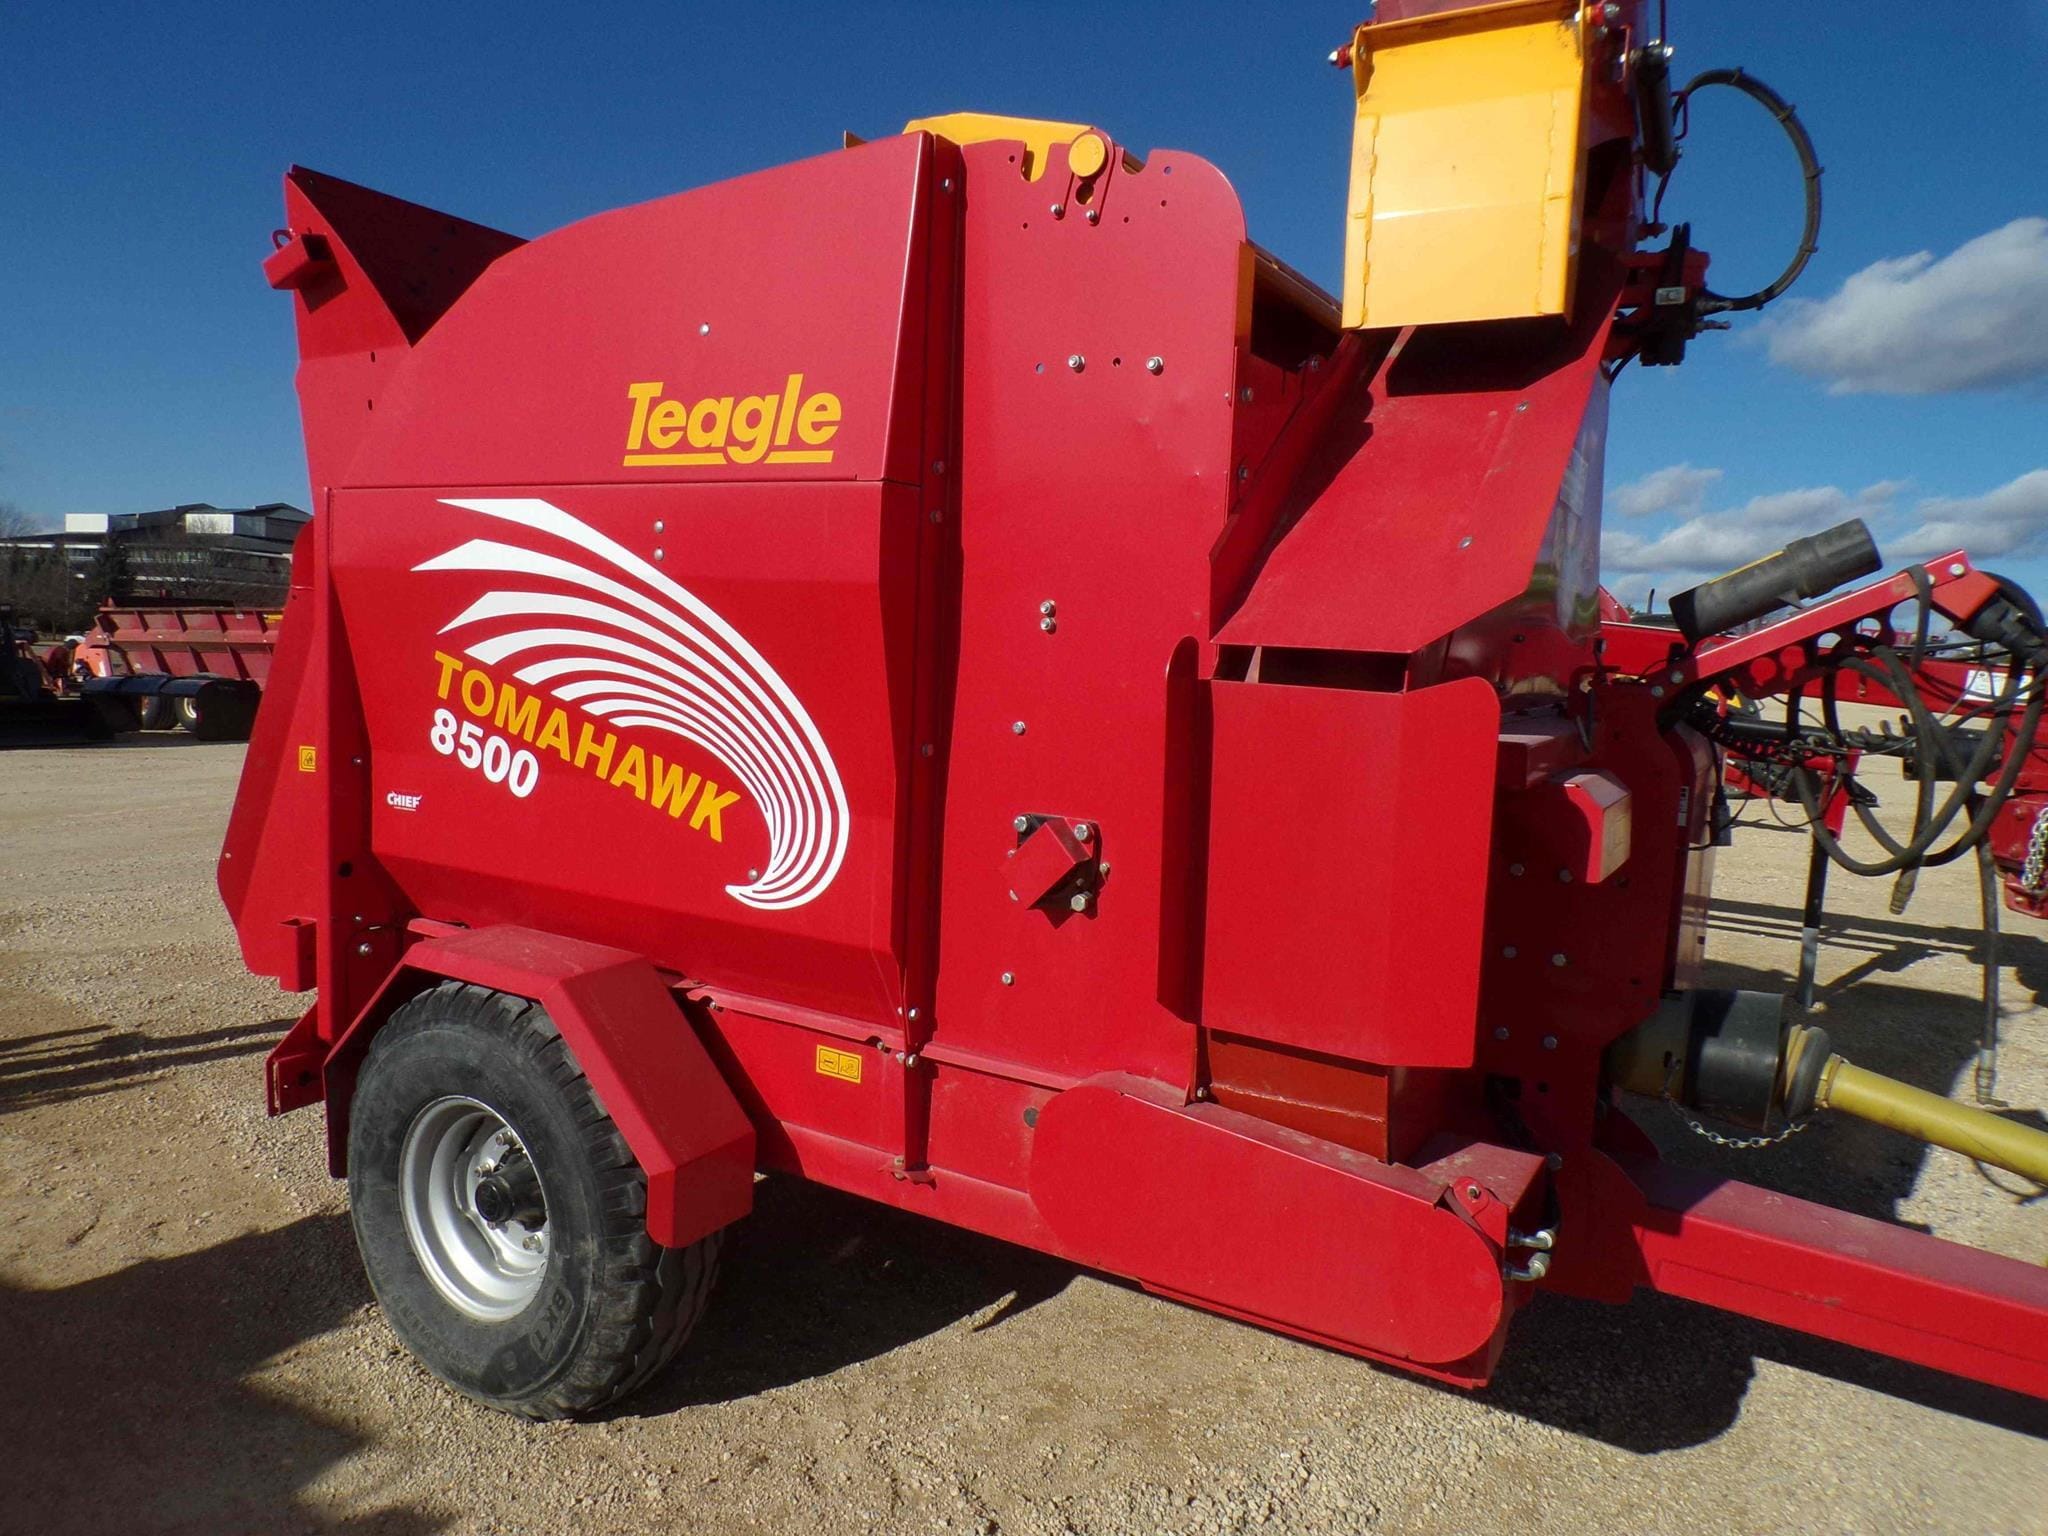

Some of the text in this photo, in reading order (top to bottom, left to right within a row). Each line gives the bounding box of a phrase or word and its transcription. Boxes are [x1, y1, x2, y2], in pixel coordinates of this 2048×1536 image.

[624, 374, 841, 465] Teagle
[429, 707, 541, 798] 8500
[434, 651, 741, 843] TOMAHAWK
[387, 791, 422, 809] CHIEF
[533, 1287, 568, 1354] BKT
